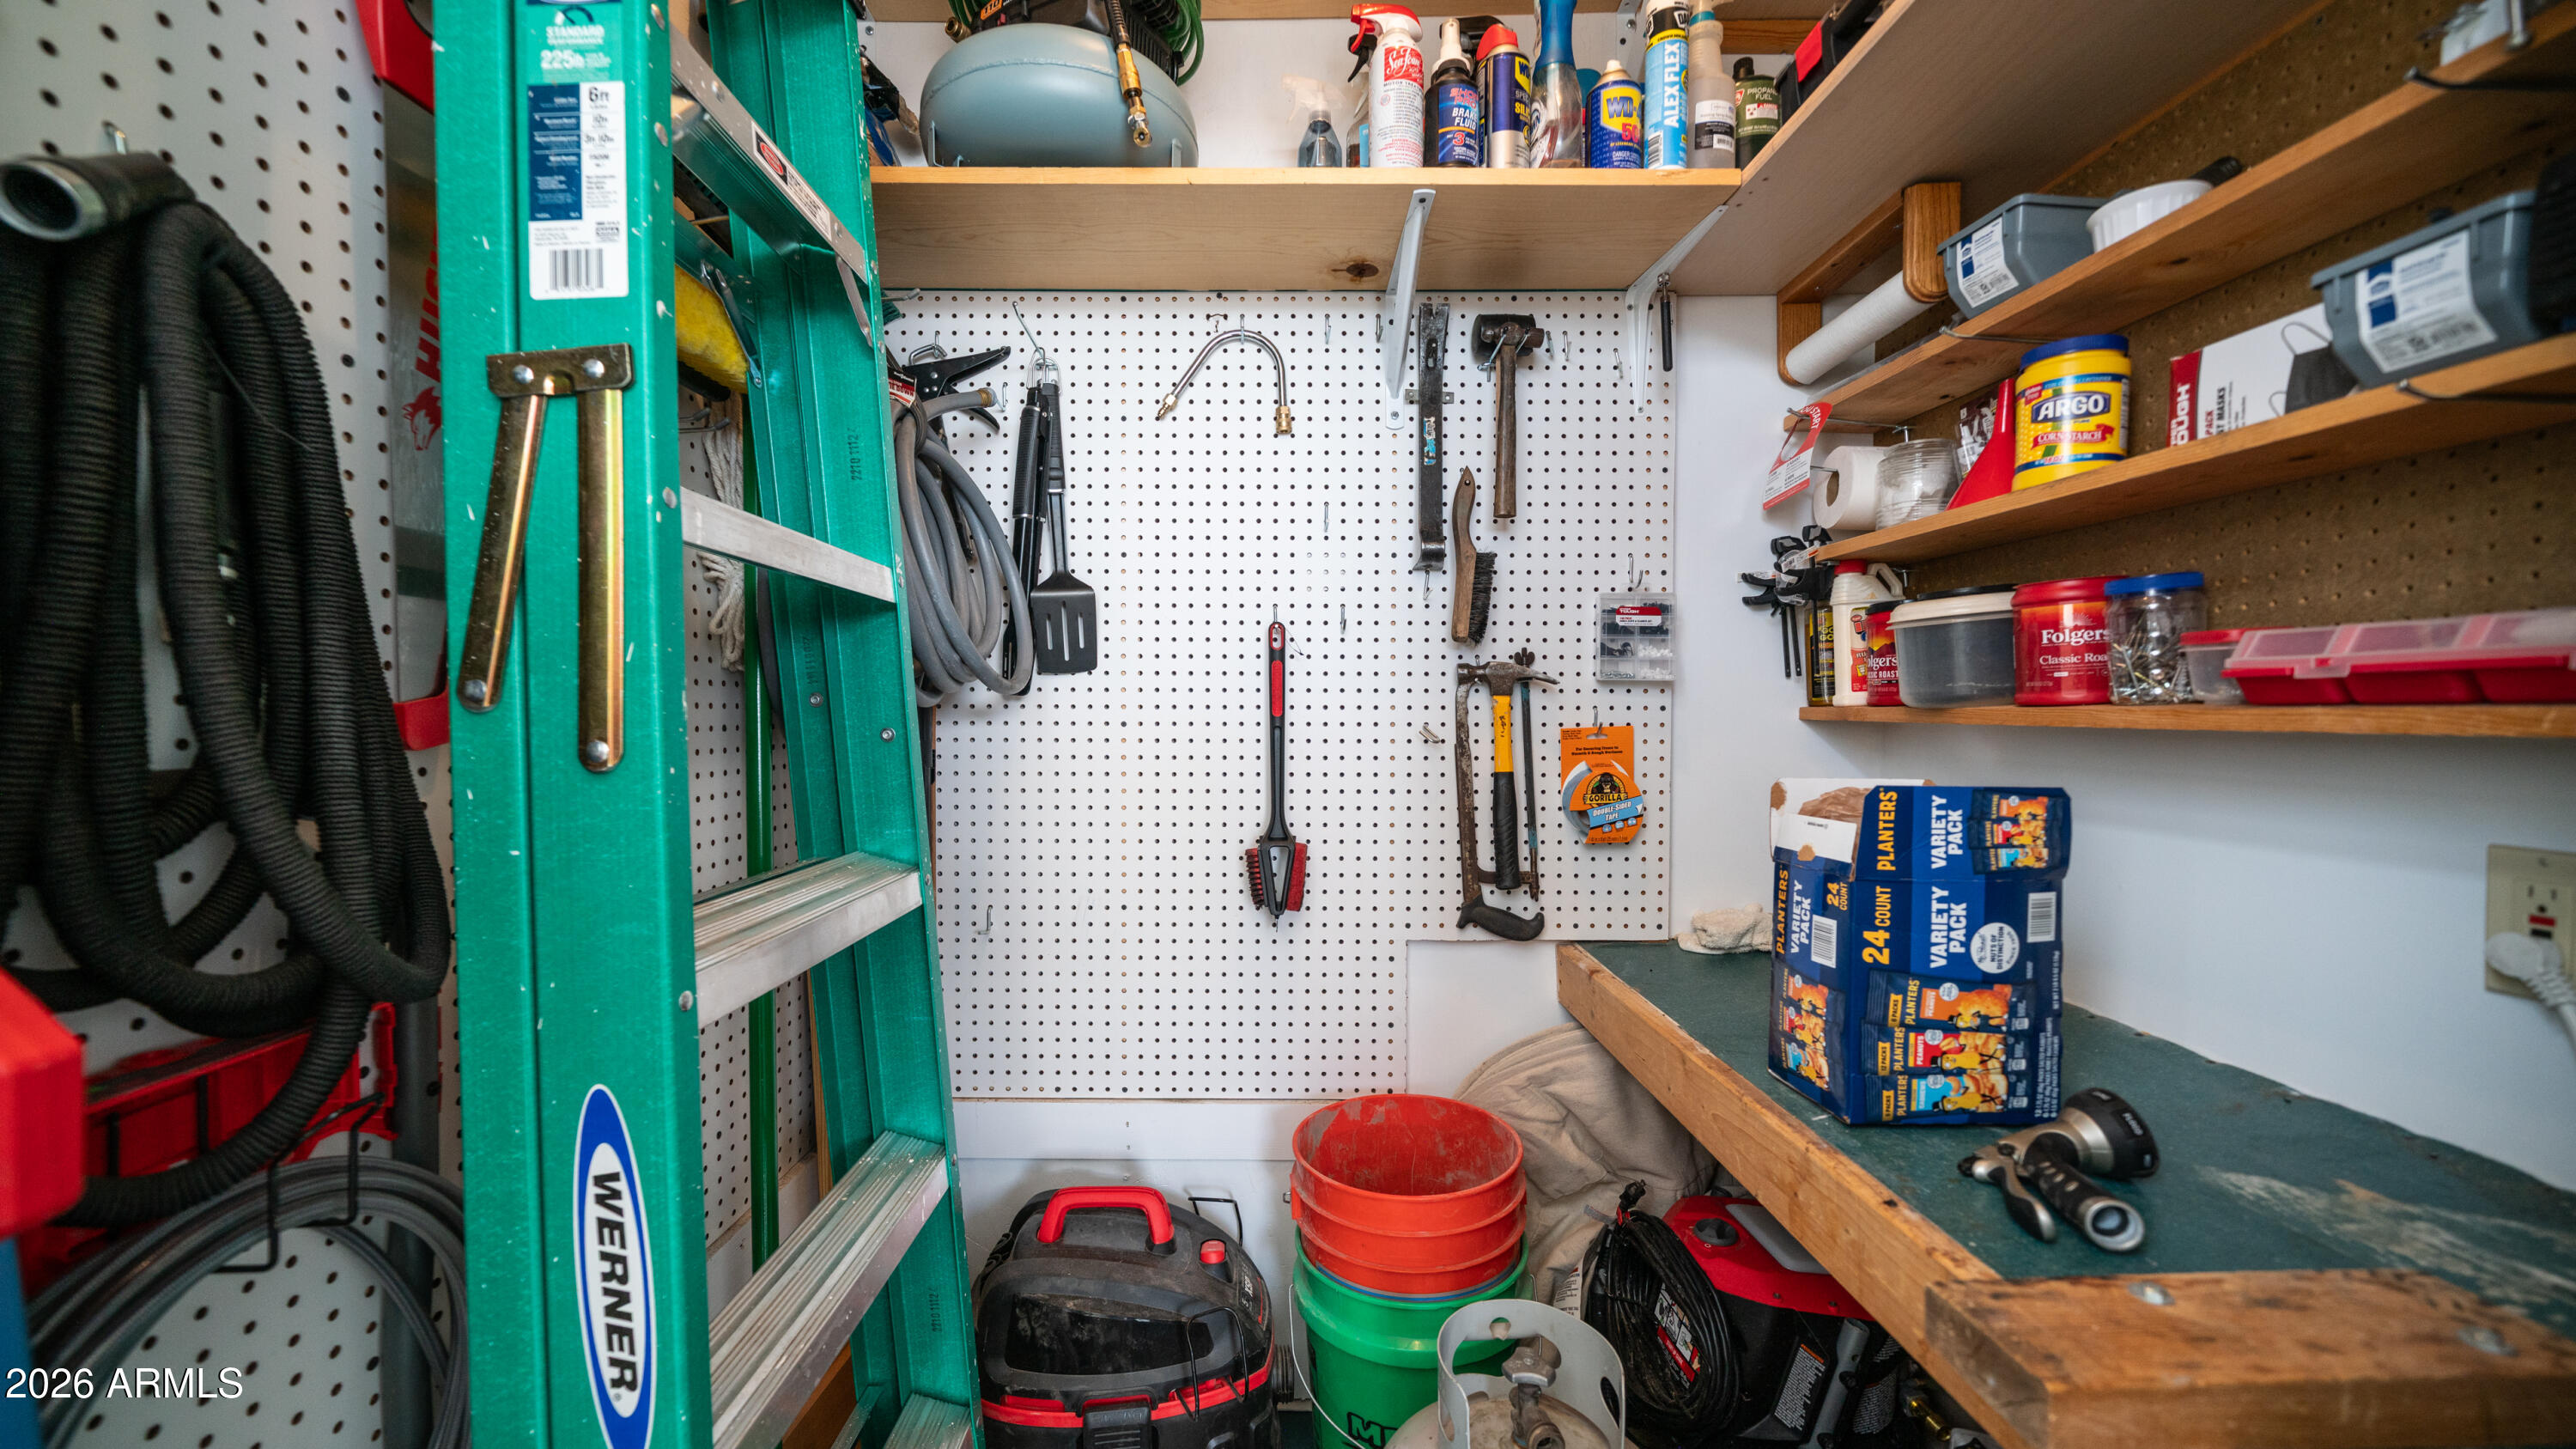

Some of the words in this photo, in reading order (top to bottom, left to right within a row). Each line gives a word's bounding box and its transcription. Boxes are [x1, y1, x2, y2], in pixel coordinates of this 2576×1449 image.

[1664, 42, 1680, 82] FLEX
[1452, 107, 1477, 121] BRAKE
[1455, 95, 1476, 109] PRO
[1663, 84, 1680, 128] ALEX
[1453, 132, 1465, 146] 3
[1455, 117, 1476, 131] FLUID
[1809, 406, 1821, 429] START
[2038, 394, 2105, 421] ARGO
[2176, 383, 2190, 445] OUGH
[2216, 387, 2226, 420] MASKS
[2041, 628, 2110, 646] Folgers
[1868, 654, 1898, 670] olgers
[1879, 670, 1899, 679] ROAST
[2039, 654, 2081, 665] Classic
[2084, 653, 2108, 662] Roa
[1589, 794, 1622, 802] GORILLA
[1593, 801, 1631, 817] DOUBLE-SIDED
[1606, 813, 1619, 821] TAPE
[1876, 791, 1898, 871] PLANTERS
[1930, 795, 1947, 869] VARIETY
[1947, 809, 1963, 855] PACK
[1776, 869, 1789, 954] PLANTERS
[1827, 882, 1839, 907] 24
[1839, 882, 1848, 910] COUNT
[1874, 886, 1892, 927] COUNT
[1790, 880, 1803, 953] VARIETY
[1800, 897, 1812, 944] PACK
[1929, 886, 1949, 968] VARIETY
[1948, 903, 1967, 953] PACK
[1862, 929, 1890, 965] 24
[1905, 980, 1920, 1025] PLANTERS
[1893, 1027, 1905, 1071] PLANTERS
[1897, 1075, 1908, 1116] PLANTERS
[2123, 1112, 2143, 1135] FLOOD
[592, 1172, 639, 1394] WERNER
